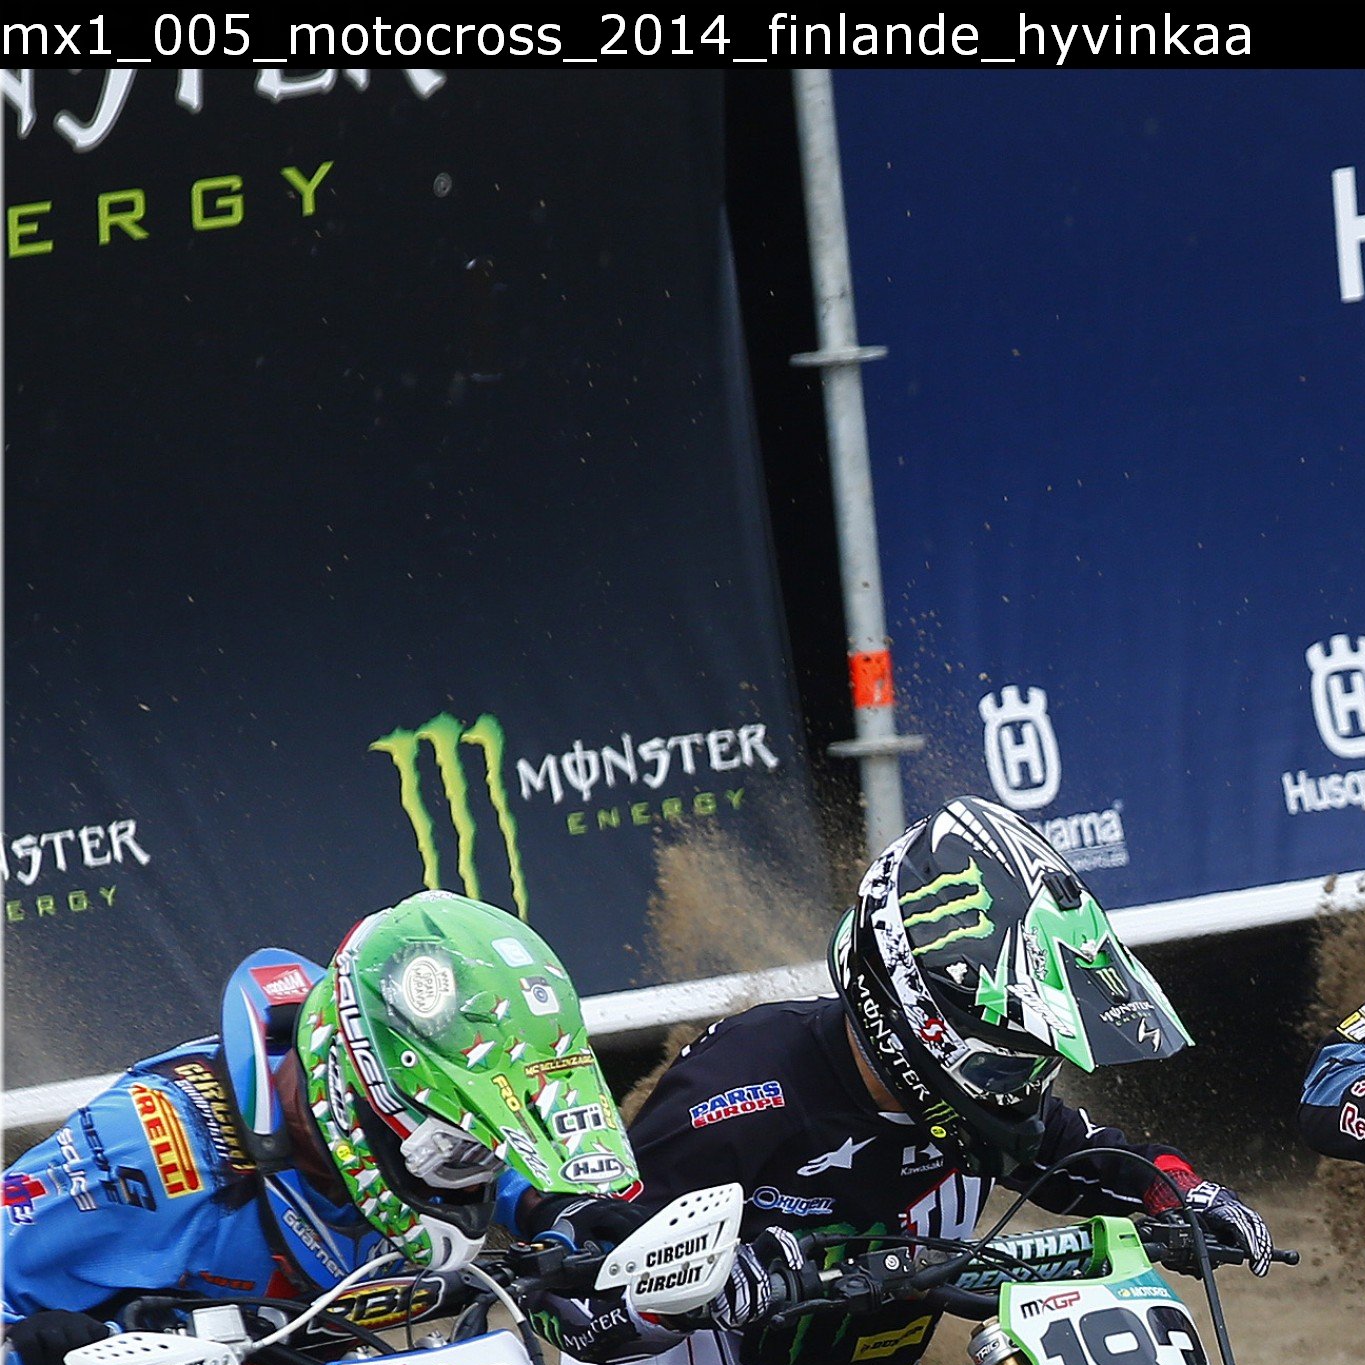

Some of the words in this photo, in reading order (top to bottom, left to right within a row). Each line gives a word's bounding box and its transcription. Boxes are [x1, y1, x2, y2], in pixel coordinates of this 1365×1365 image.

[566, 788, 748, 837] ENERGY
[690, 1080, 783, 1119] PARTS
[692, 1095, 787, 1129] EUROPE
[572, 1158, 620, 1178] HJC
[900, 1160, 944, 1177] Kawasaki
[645, 1233, 710, 1269] CIRCUIT
[635, 1264, 703, 1296] CIRCUIT
[1020, 1290, 1081, 1320] MXGP
